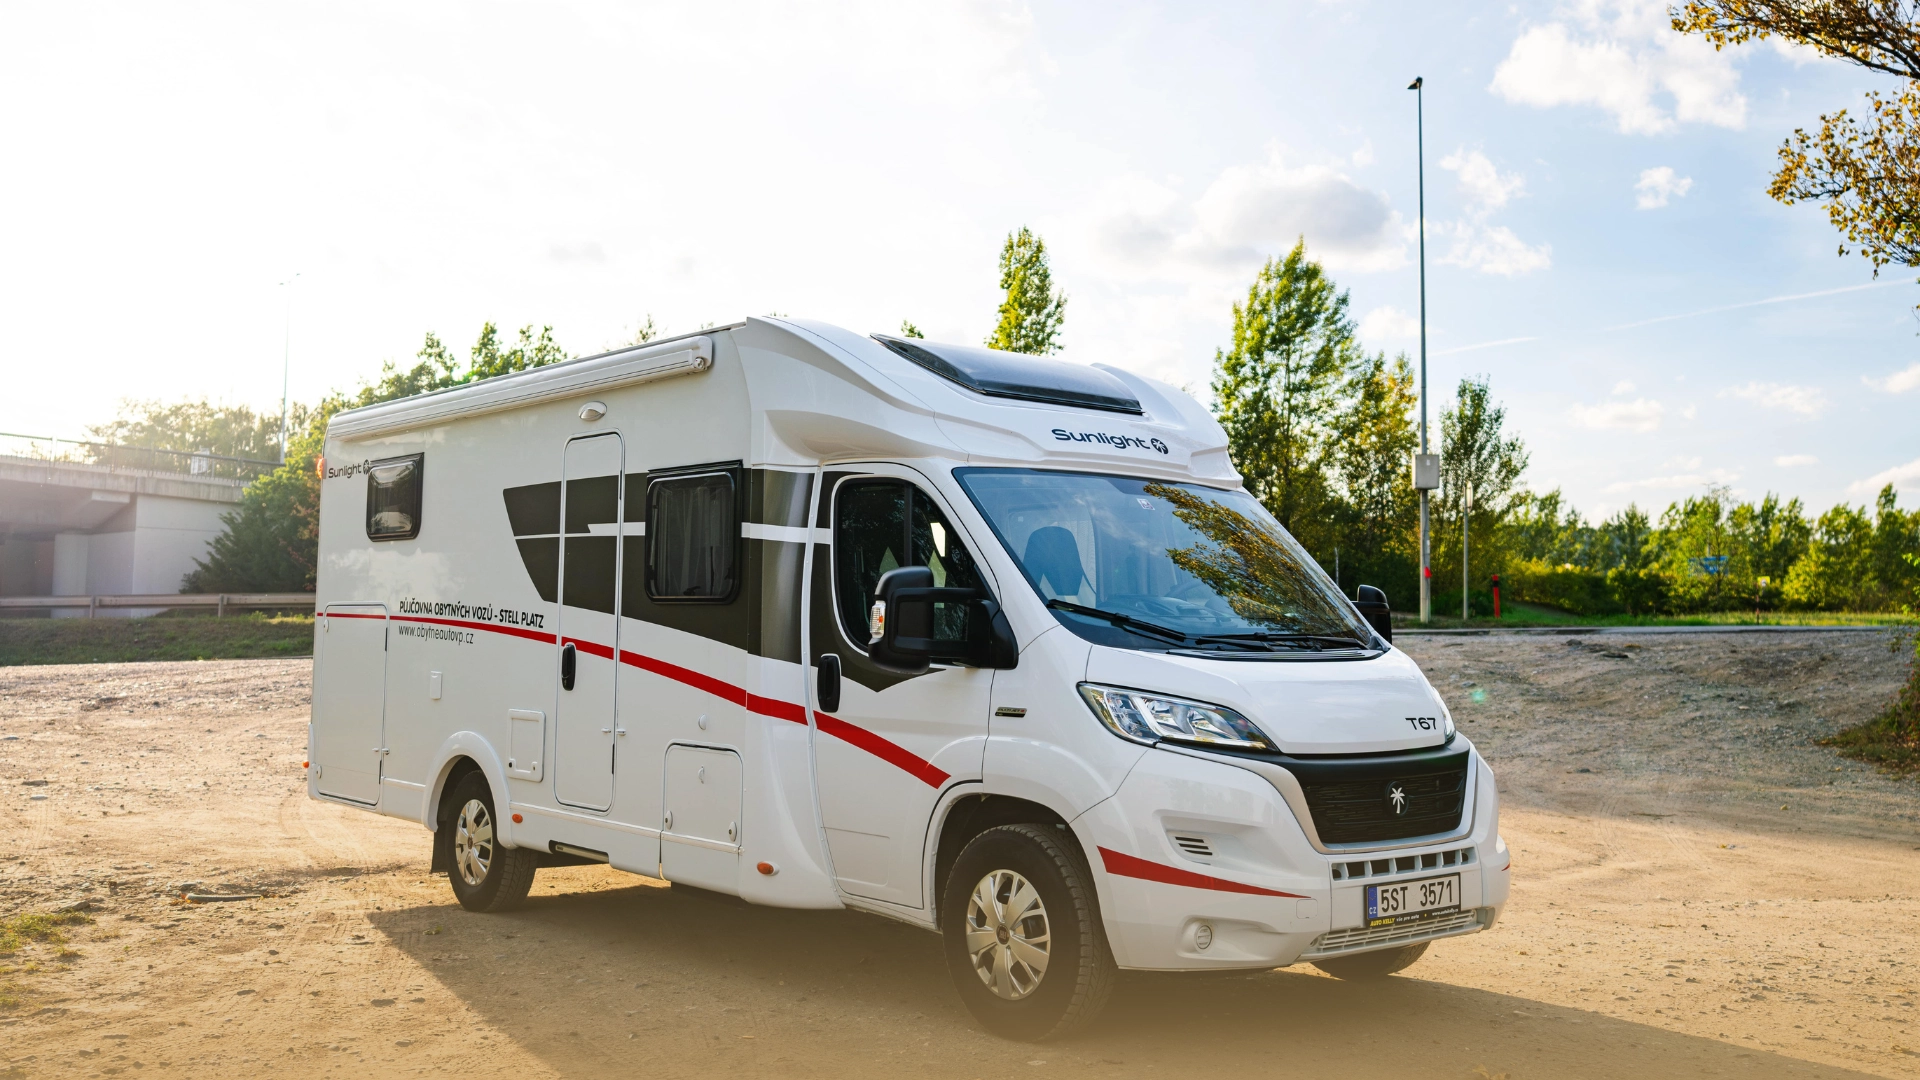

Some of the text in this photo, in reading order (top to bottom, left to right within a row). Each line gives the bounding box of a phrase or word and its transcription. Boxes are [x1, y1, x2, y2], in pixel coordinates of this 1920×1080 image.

[1051, 428, 1151, 450] Sunlight
[328, 463, 362, 479] Sunlight
[434, 600, 471, 619] OBYTNÝCH
[472, 603, 493, 621] VOZŮ
[499, 608, 520, 625] STELL
[521, 611, 544, 629] PLATZ
[398, 624, 474, 646] www.obytneautovp.cz
[1405, 717, 1437, 731] T67
[1381, 880, 1453, 913] 5ST 3571
[1369, 907, 1377, 915] CZ
